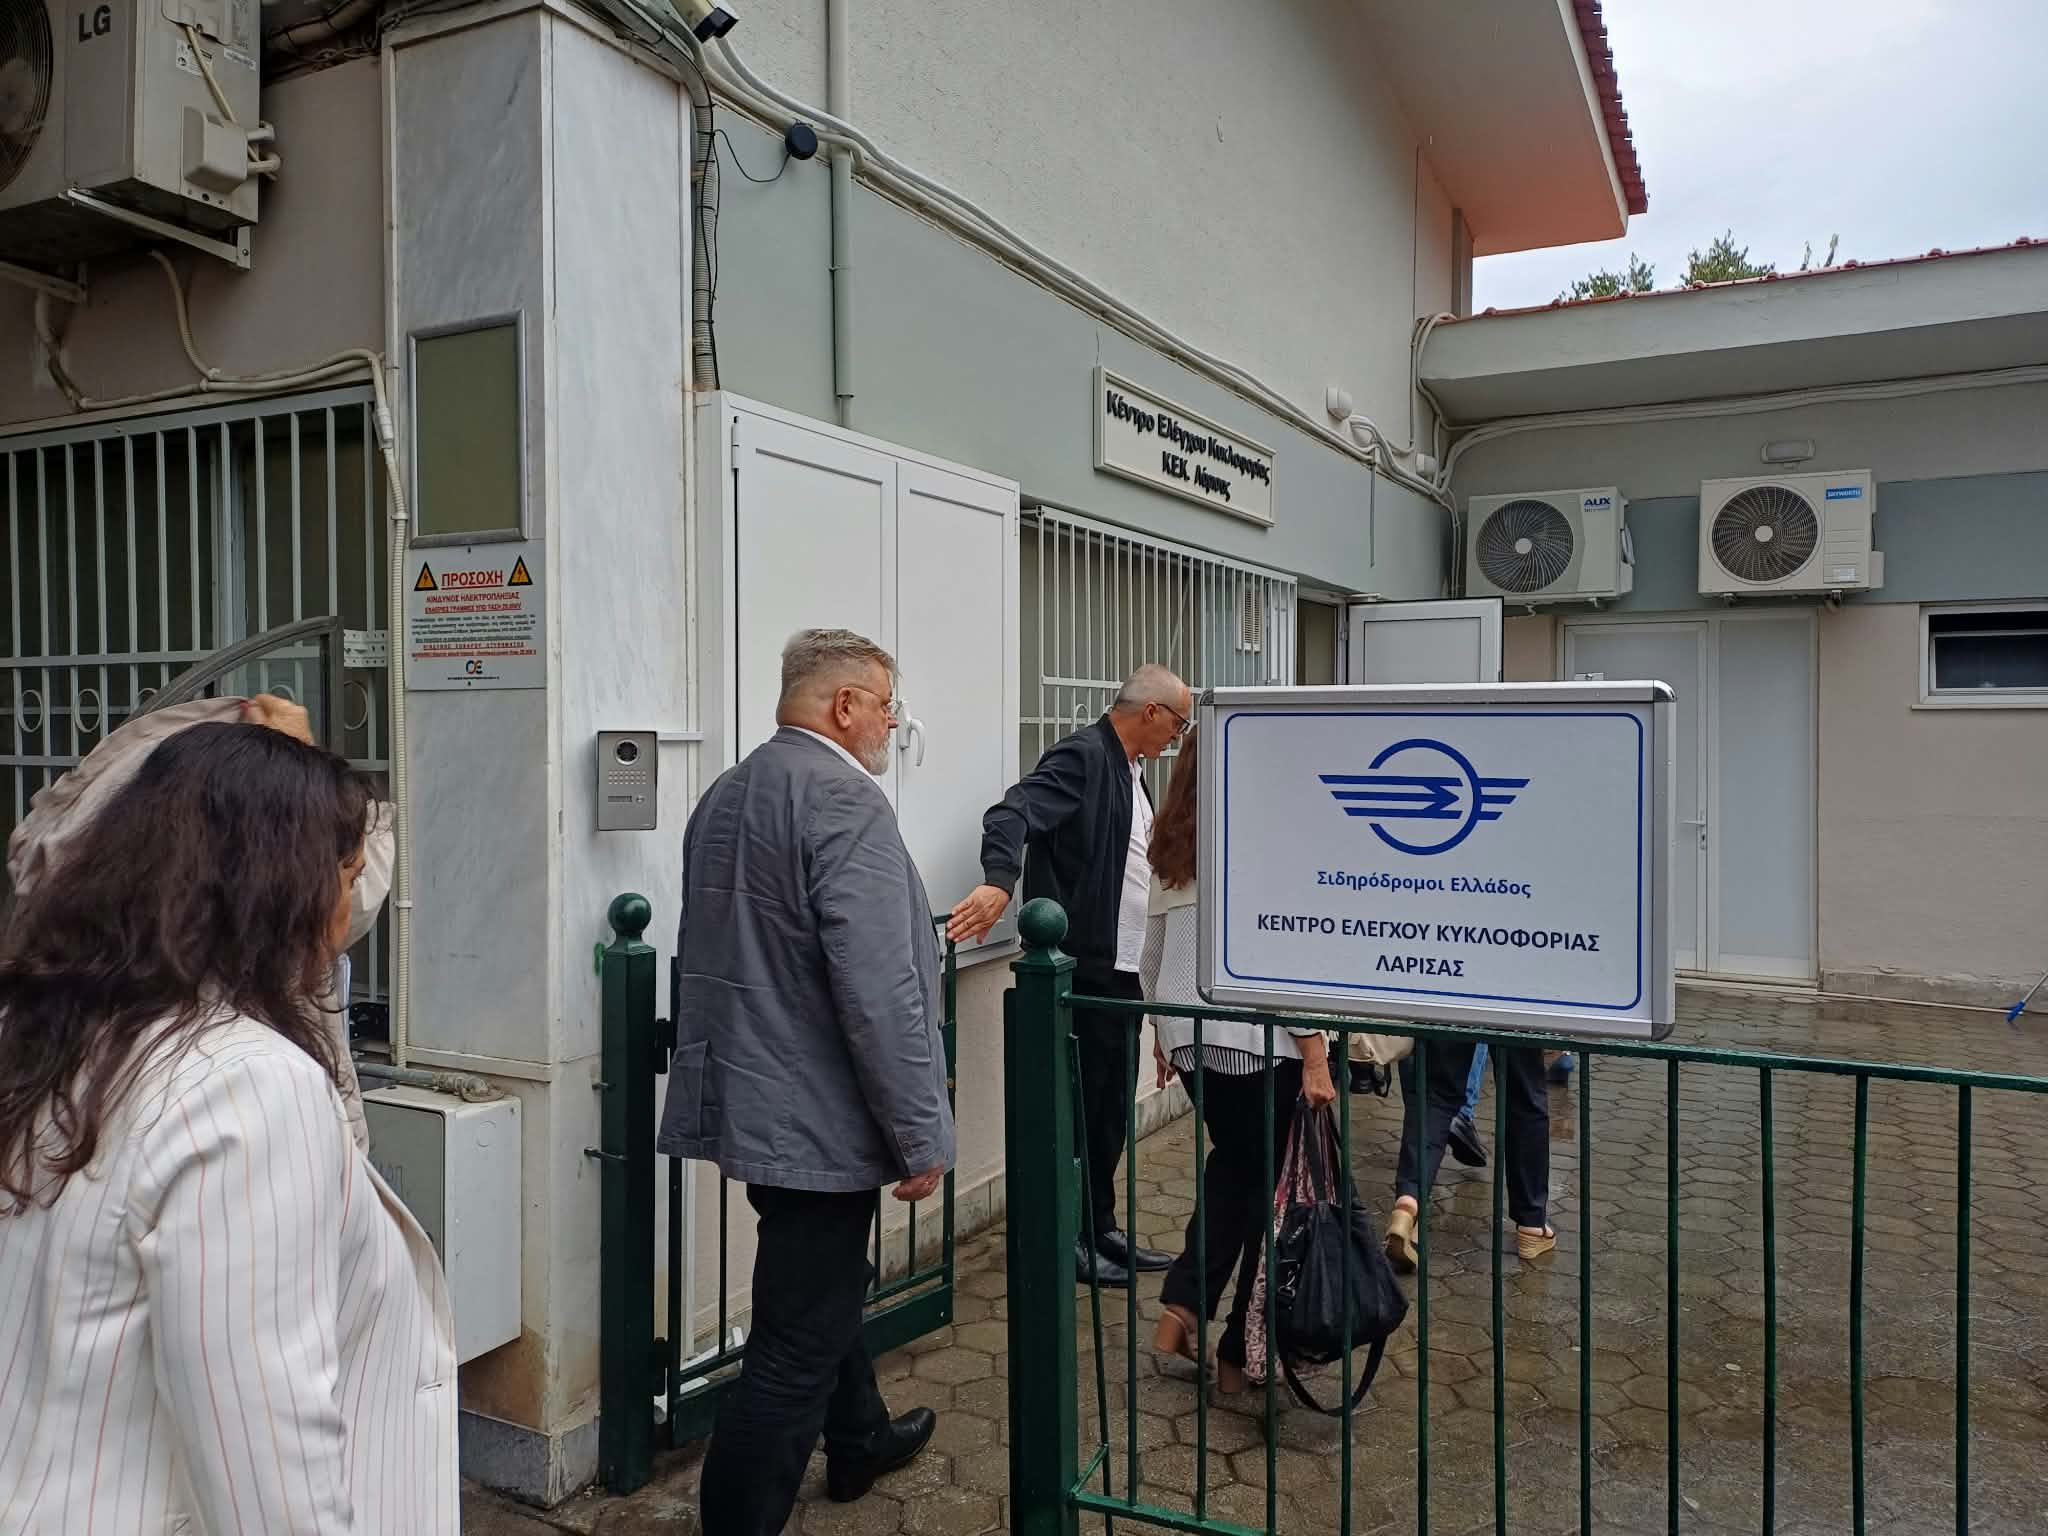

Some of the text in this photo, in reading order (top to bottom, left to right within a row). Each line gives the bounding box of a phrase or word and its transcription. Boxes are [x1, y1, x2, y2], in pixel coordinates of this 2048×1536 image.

[79, 5, 111, 43] LG
[1106, 389, 1155, 435] Κέντρο
[1157, 413, 1207, 454] Ελέγχου
[1584, 497, 1611, 506] AUX
[441, 571, 503, 587] ΠΡΟΣΟΧΗ
[1317, 870, 1532, 898] Σιδηρόδρομοι Ελλάδος
[1258, 913, 1600, 952] ΚΕΝΤΡΟ ΕΛΕΓΧΟΥ ΚΥΚΛΟΦΟΡΙΑΣ
[1376, 955, 1465, 977] ΛΑΡΙΣΑΣ
